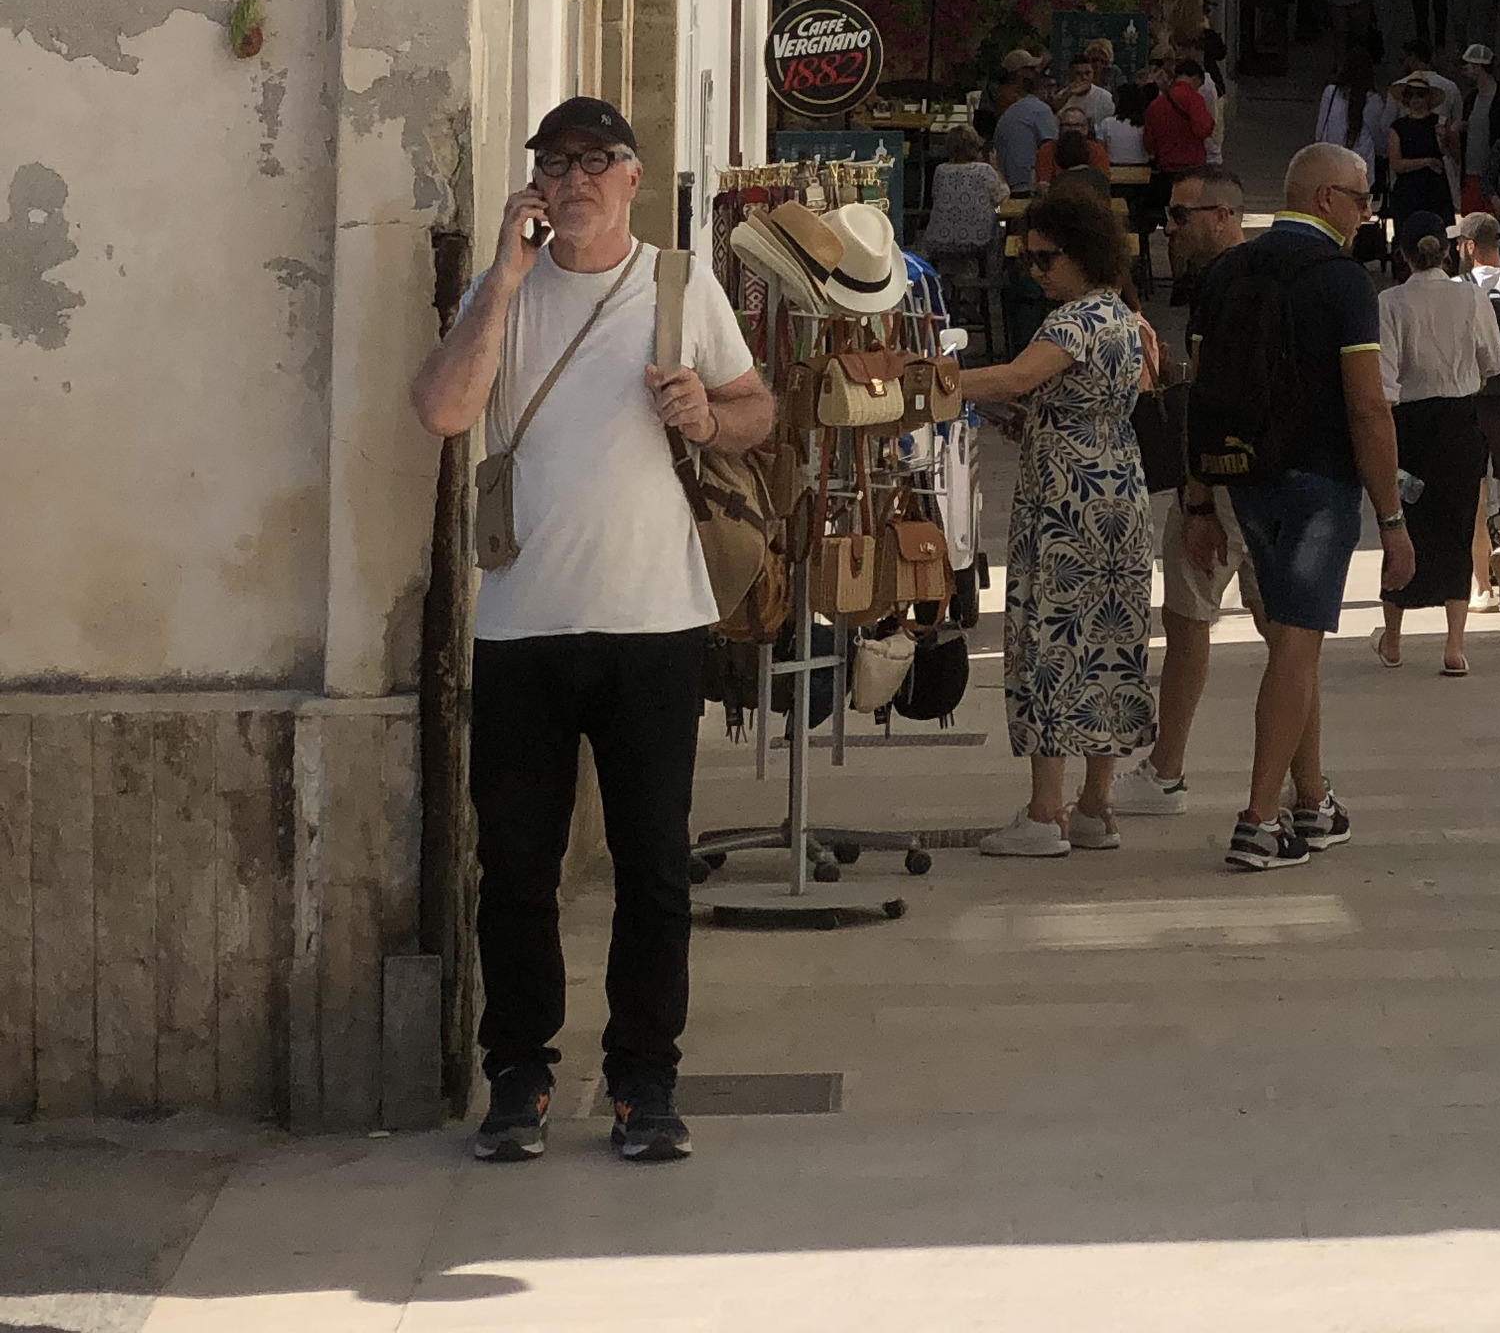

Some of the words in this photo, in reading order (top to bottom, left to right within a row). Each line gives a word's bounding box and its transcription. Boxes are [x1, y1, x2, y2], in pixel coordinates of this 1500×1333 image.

[796, 13, 848, 37] CAFFÈ
[773, 29, 871, 59] VERGNANO
[781, 51, 863, 91] 1882
